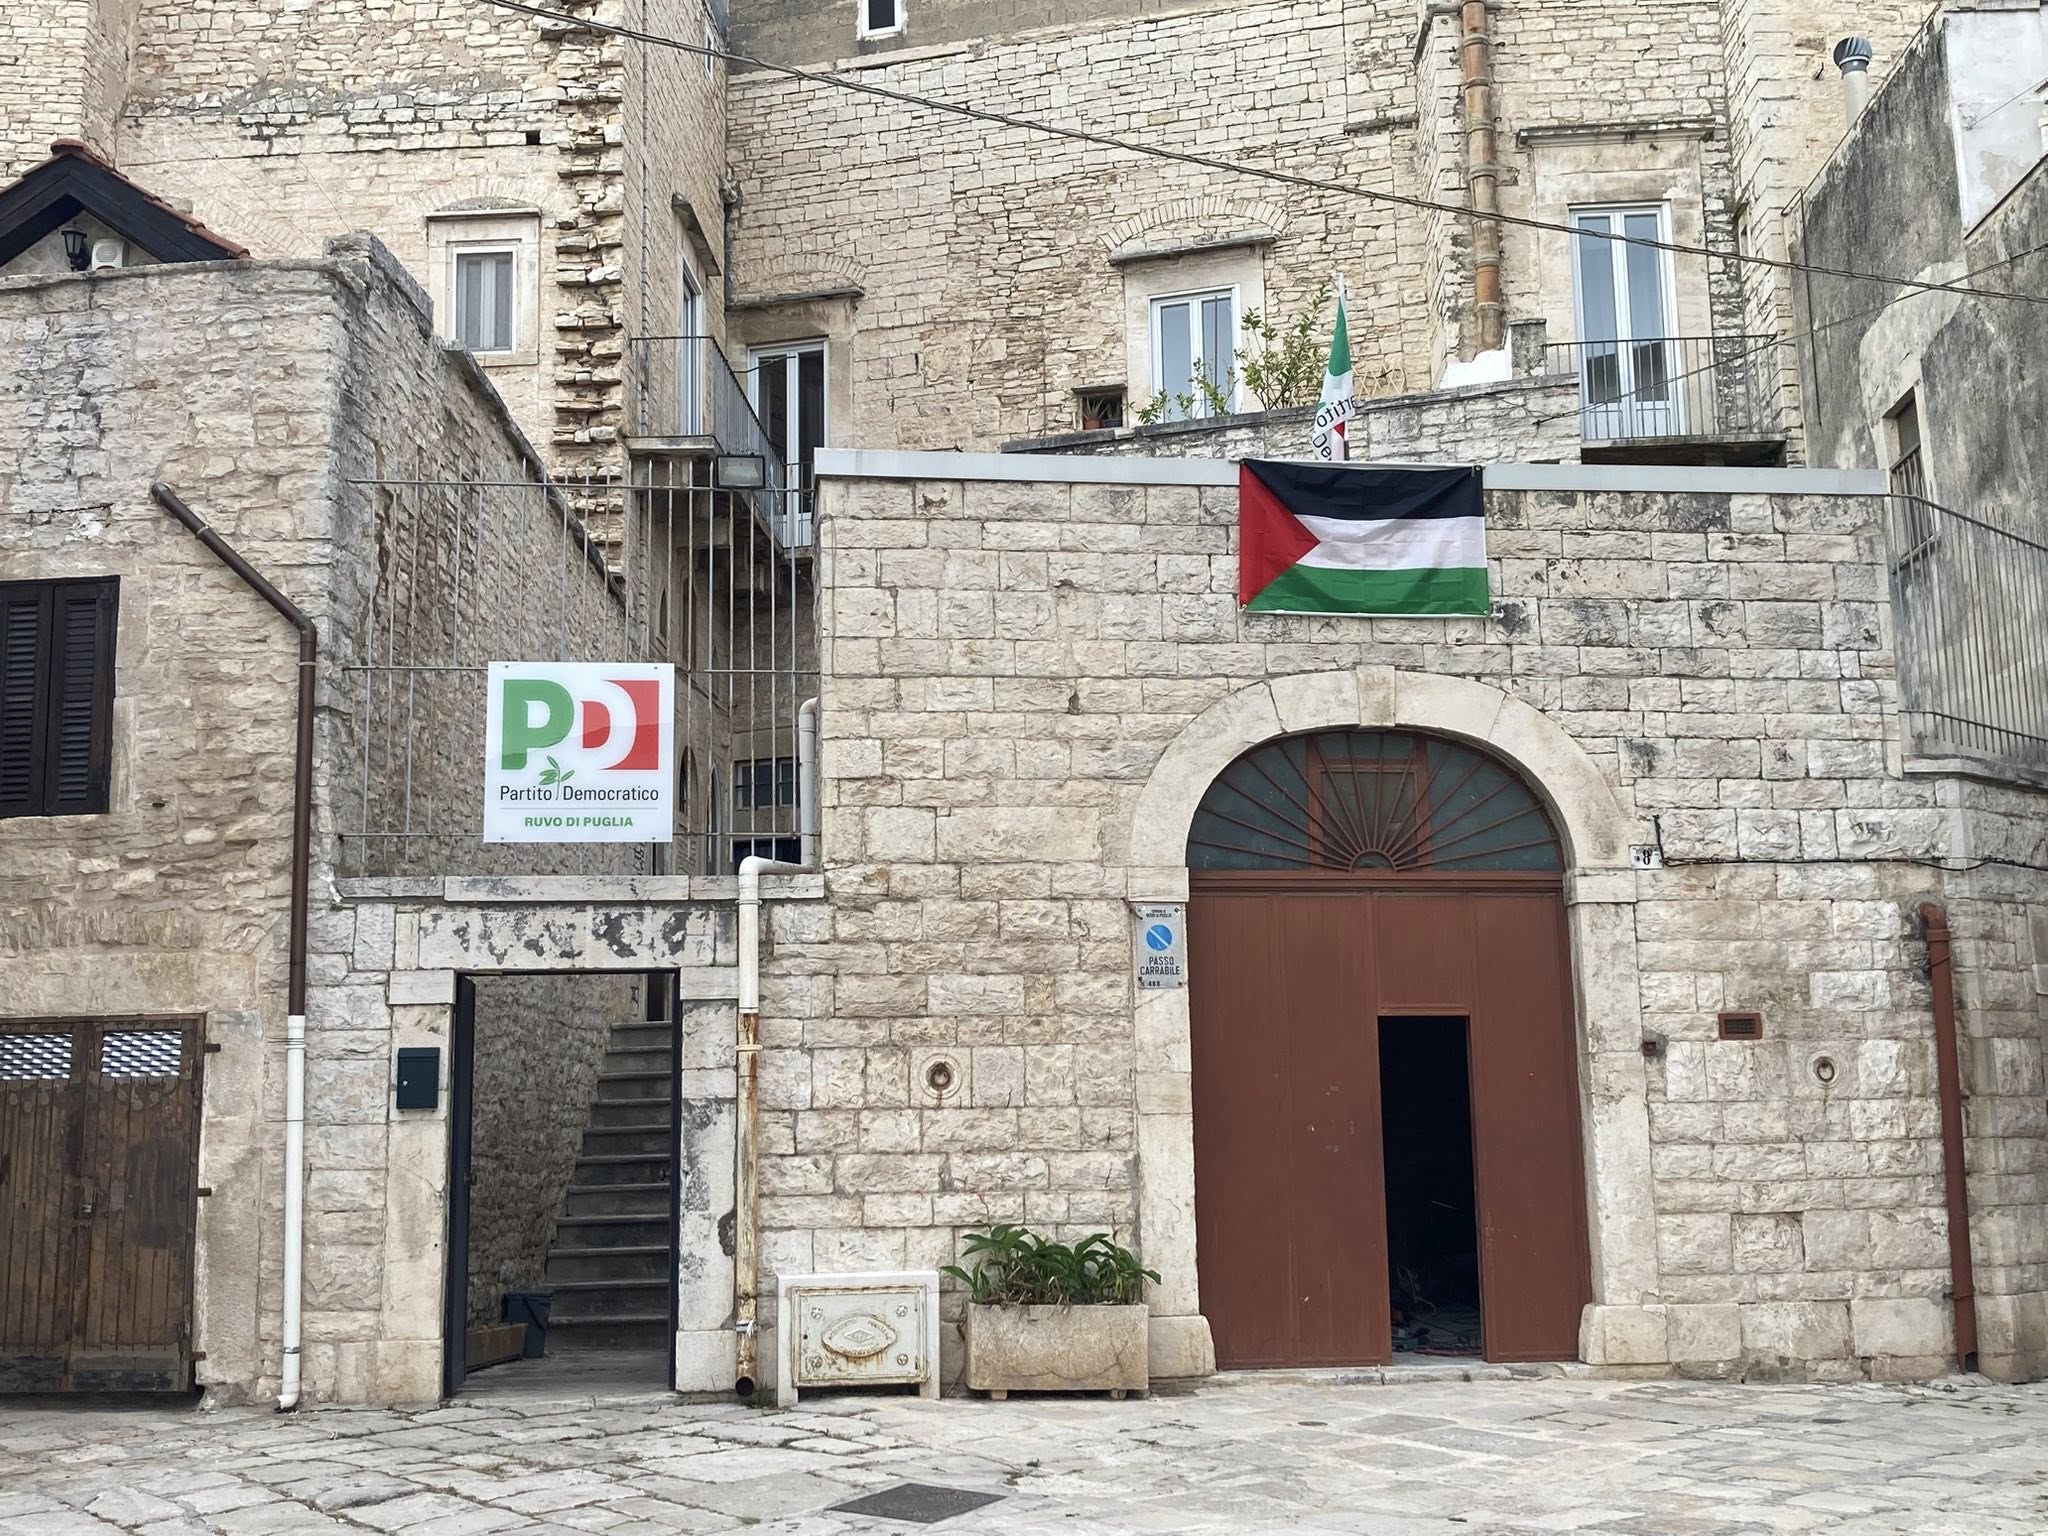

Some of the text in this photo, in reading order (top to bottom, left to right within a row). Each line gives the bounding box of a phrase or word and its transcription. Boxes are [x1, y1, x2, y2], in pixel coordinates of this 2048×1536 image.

[501, 679, 659, 770] PD
[500, 785, 659, 801] Partito Democratico
[525, 817, 633, 827] RUVO DI PUGLIA
[1149, 956, 1174, 965] PASSO
[1140, 966, 1180, 975] CARRABILE
